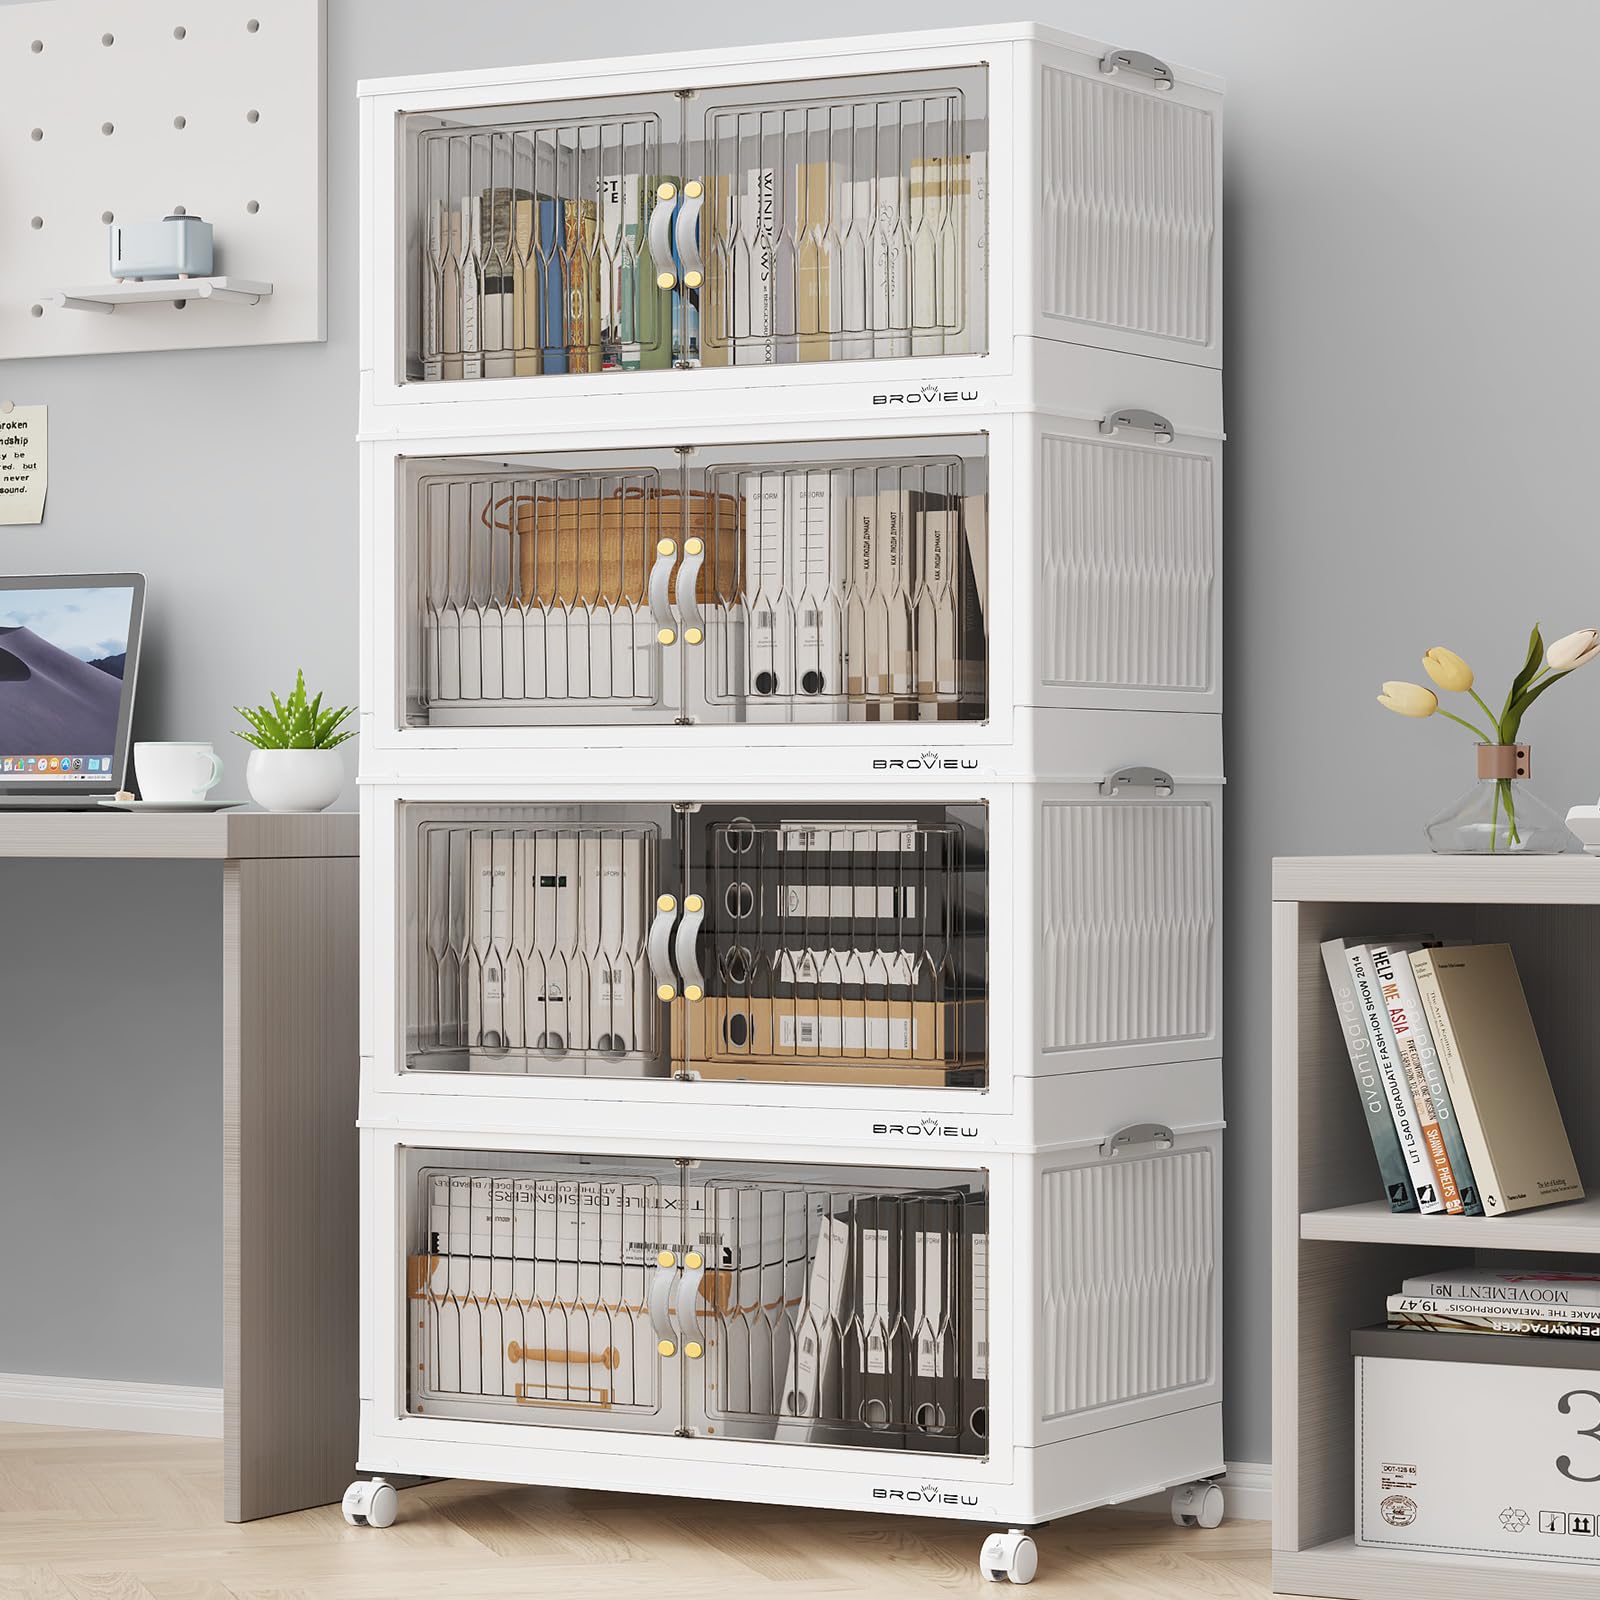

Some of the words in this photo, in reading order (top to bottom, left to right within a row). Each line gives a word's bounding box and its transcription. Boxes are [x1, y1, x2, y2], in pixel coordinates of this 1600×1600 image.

[872, 390, 978, 405] BROVIEW
[22, 462, 37, 470] but
[872, 758, 978, 769] BROVIEW
[1351, 956, 1366, 979] 2014
[1358, 981, 1375, 1012] SHOW
[1372, 951, 1394, 981] HELP
[1388, 1008, 1409, 1035] ASIA
[1337, 986, 1383, 1114] avantgarde
[1383, 1061, 1407, 1118] GRADUATE
[872, 1124, 978, 1137] BROVIEW
[1400, 1119, 1416, 1147] LSAD
[1426, 1129, 1442, 1158] SHAWN
[1438, 1166, 1457, 1198] PHELPS
[1458, 1285, 1569, 1303] MOOVEMENT
[1399, 1300, 1438, 1312] 19,47
[1548, 1309, 1567, 1318] THE
[1571, 1311, 1600, 1320] MAKE
[1492, 1321, 1600, 1337] PENNYPACKER
[872, 1488, 978, 1505] BROVIEW
